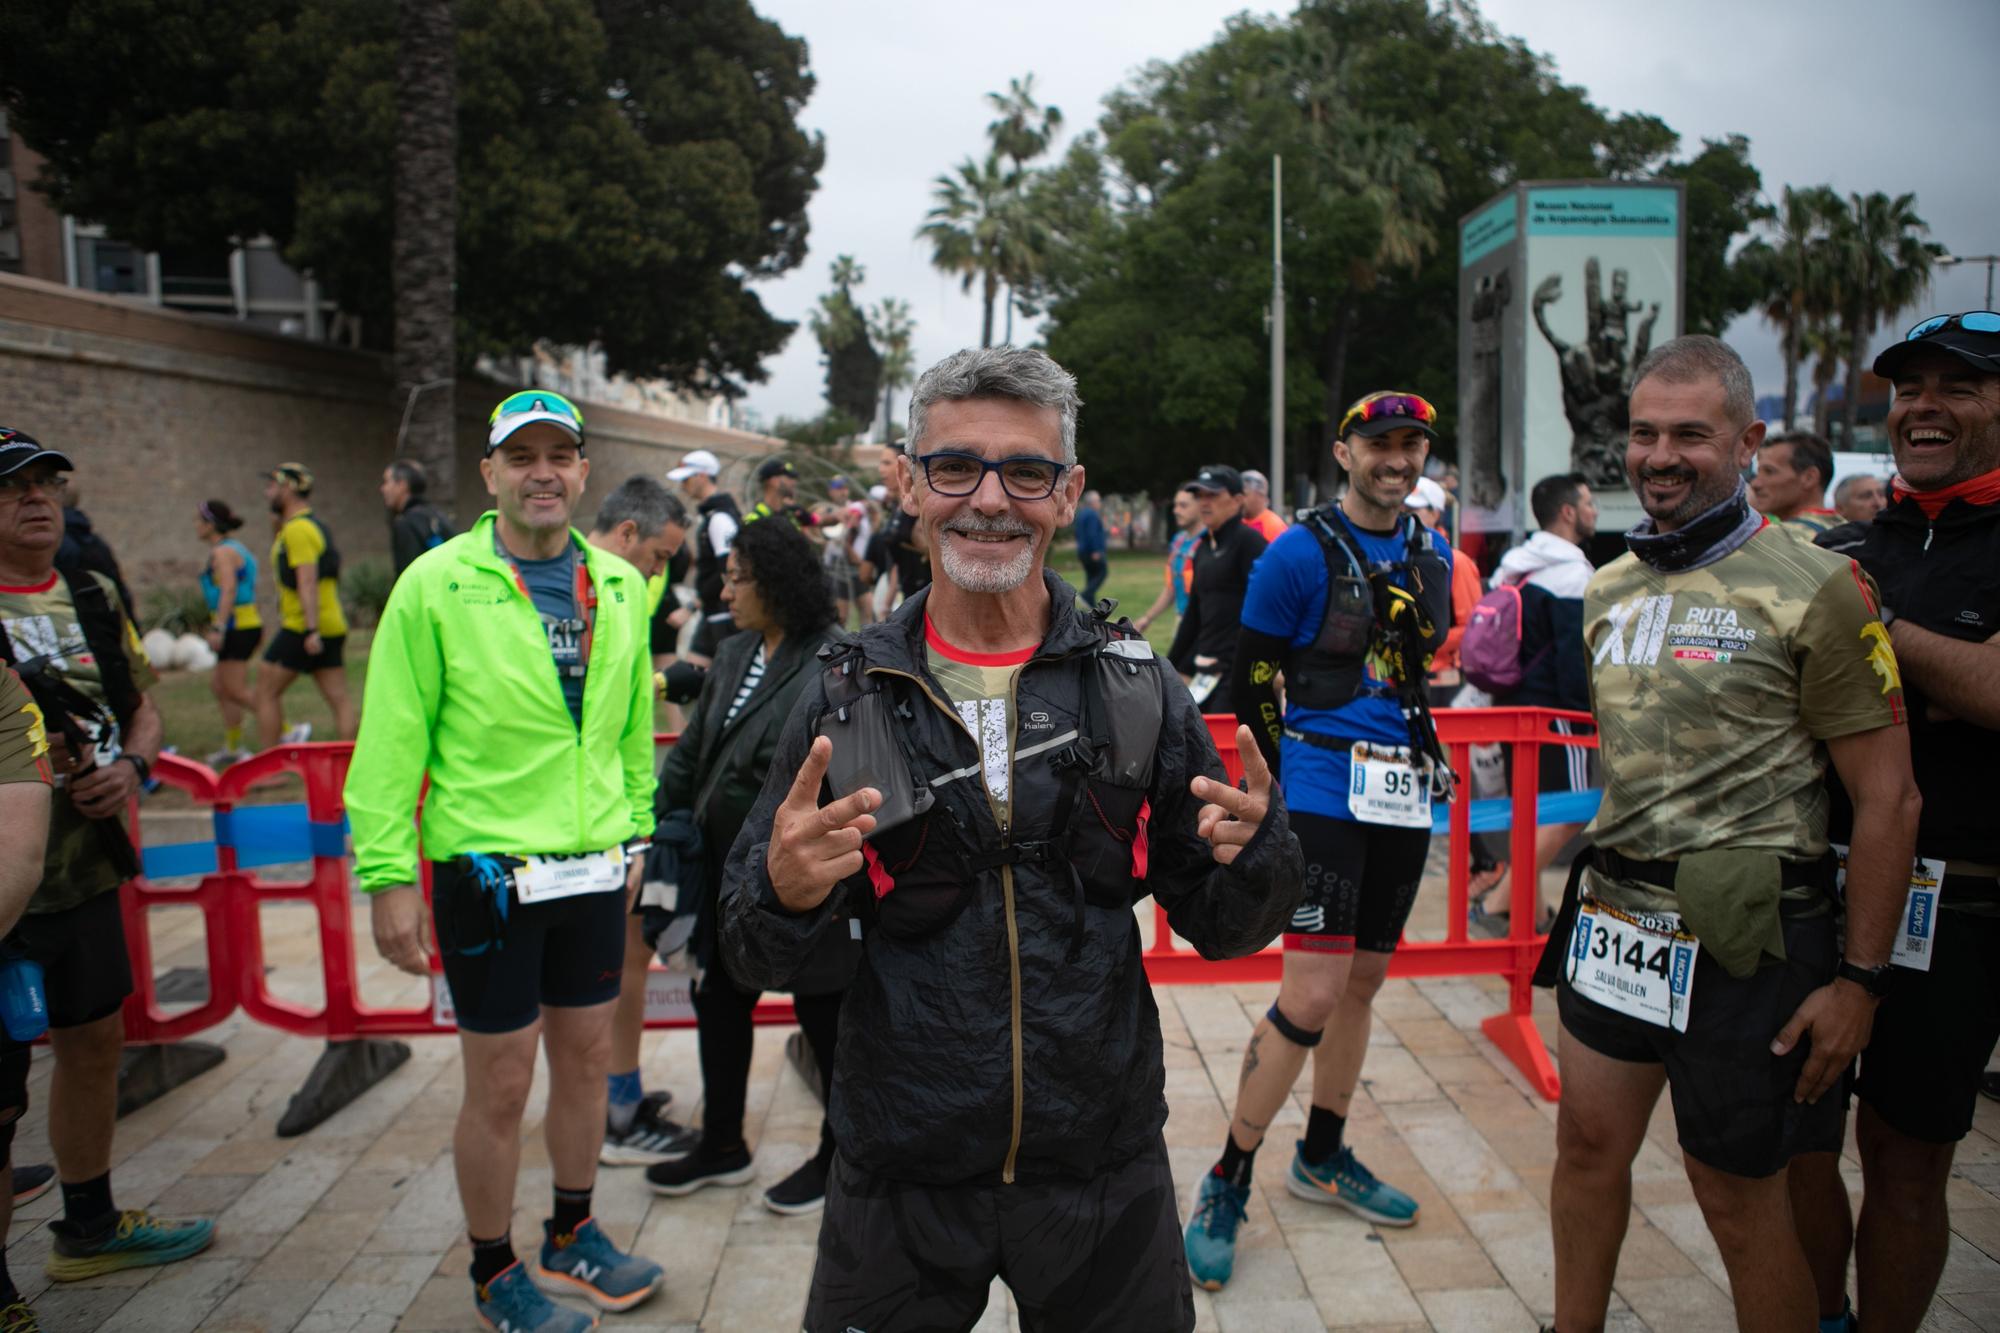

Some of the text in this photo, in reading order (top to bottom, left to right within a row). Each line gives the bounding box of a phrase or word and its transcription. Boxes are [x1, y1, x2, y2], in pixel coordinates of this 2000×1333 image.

[1534, 201, 1613, 210] Museo Nacional
[1685, 606, 1738, 627] RUTA
[1667, 623, 1757, 641] FORTALEZAS
[1669, 637, 1748, 651] CARTAGENA 2023
[1682, 651, 1716, 660] SPAR
[1385, 770, 1412, 796] 95
[1638, 916, 1674, 933] 2023
[1592, 926, 1670, 981] 3144
[1595, 969, 1616, 986] SALVA
